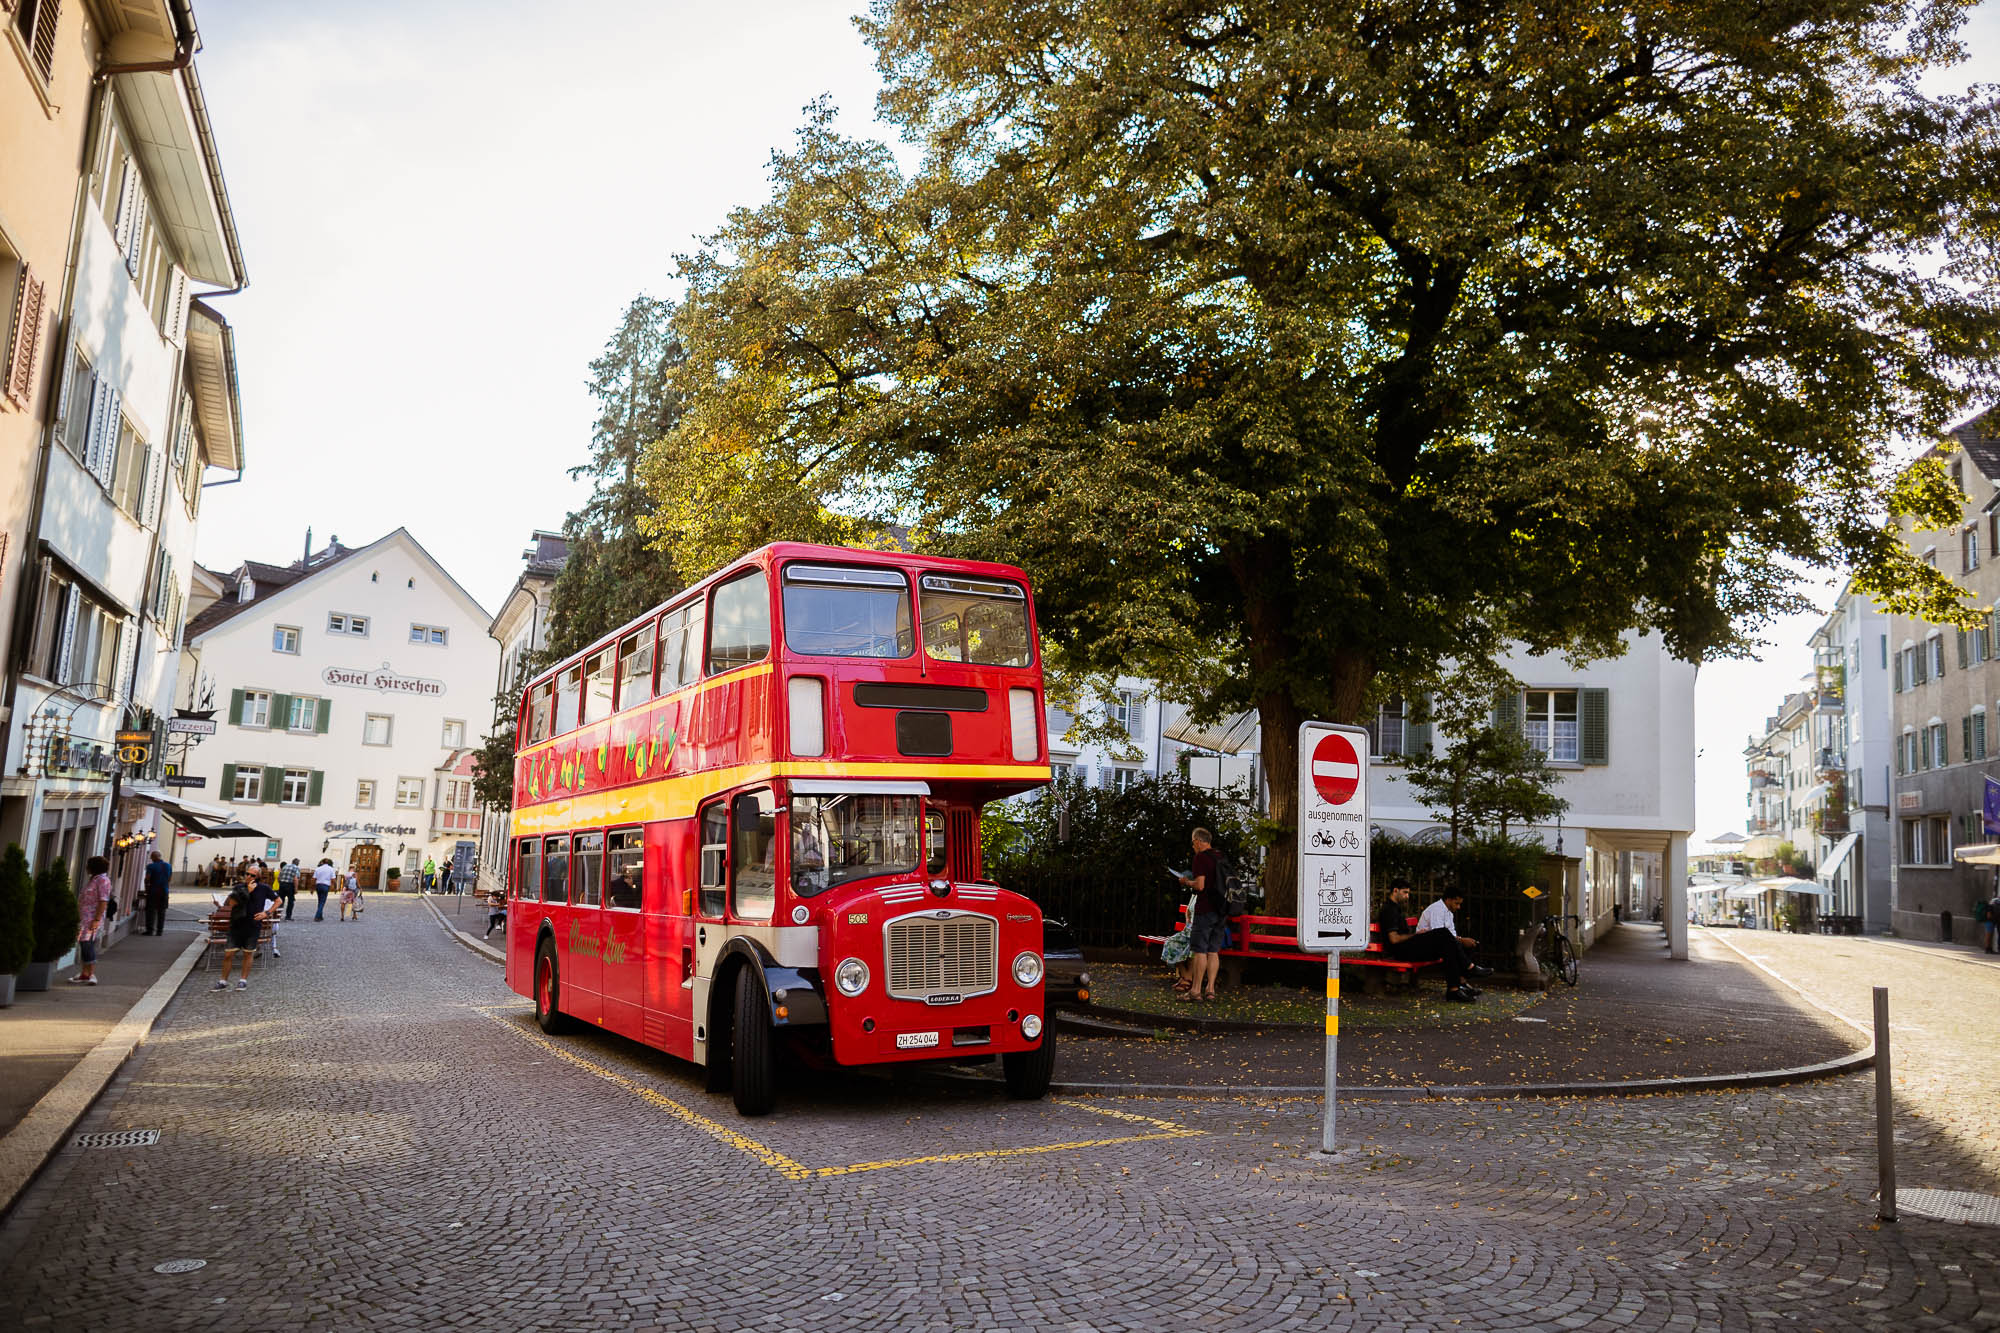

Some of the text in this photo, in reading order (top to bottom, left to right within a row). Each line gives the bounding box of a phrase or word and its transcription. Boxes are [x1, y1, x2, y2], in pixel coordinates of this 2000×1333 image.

[326, 669, 441, 695] Hotel Hirschen
[172, 721, 213, 732] Pizzeria
[560, 743, 586, 792] have
[1308, 810, 1363, 823] ausgenommen
[323, 821, 360, 833] Hotel
[1319, 907, 1343, 917] PILGER
[849, 914, 867, 924] 503
[1319, 915, 1353, 925] HERBERGE
[569, 917, 626, 966] Classic Line
